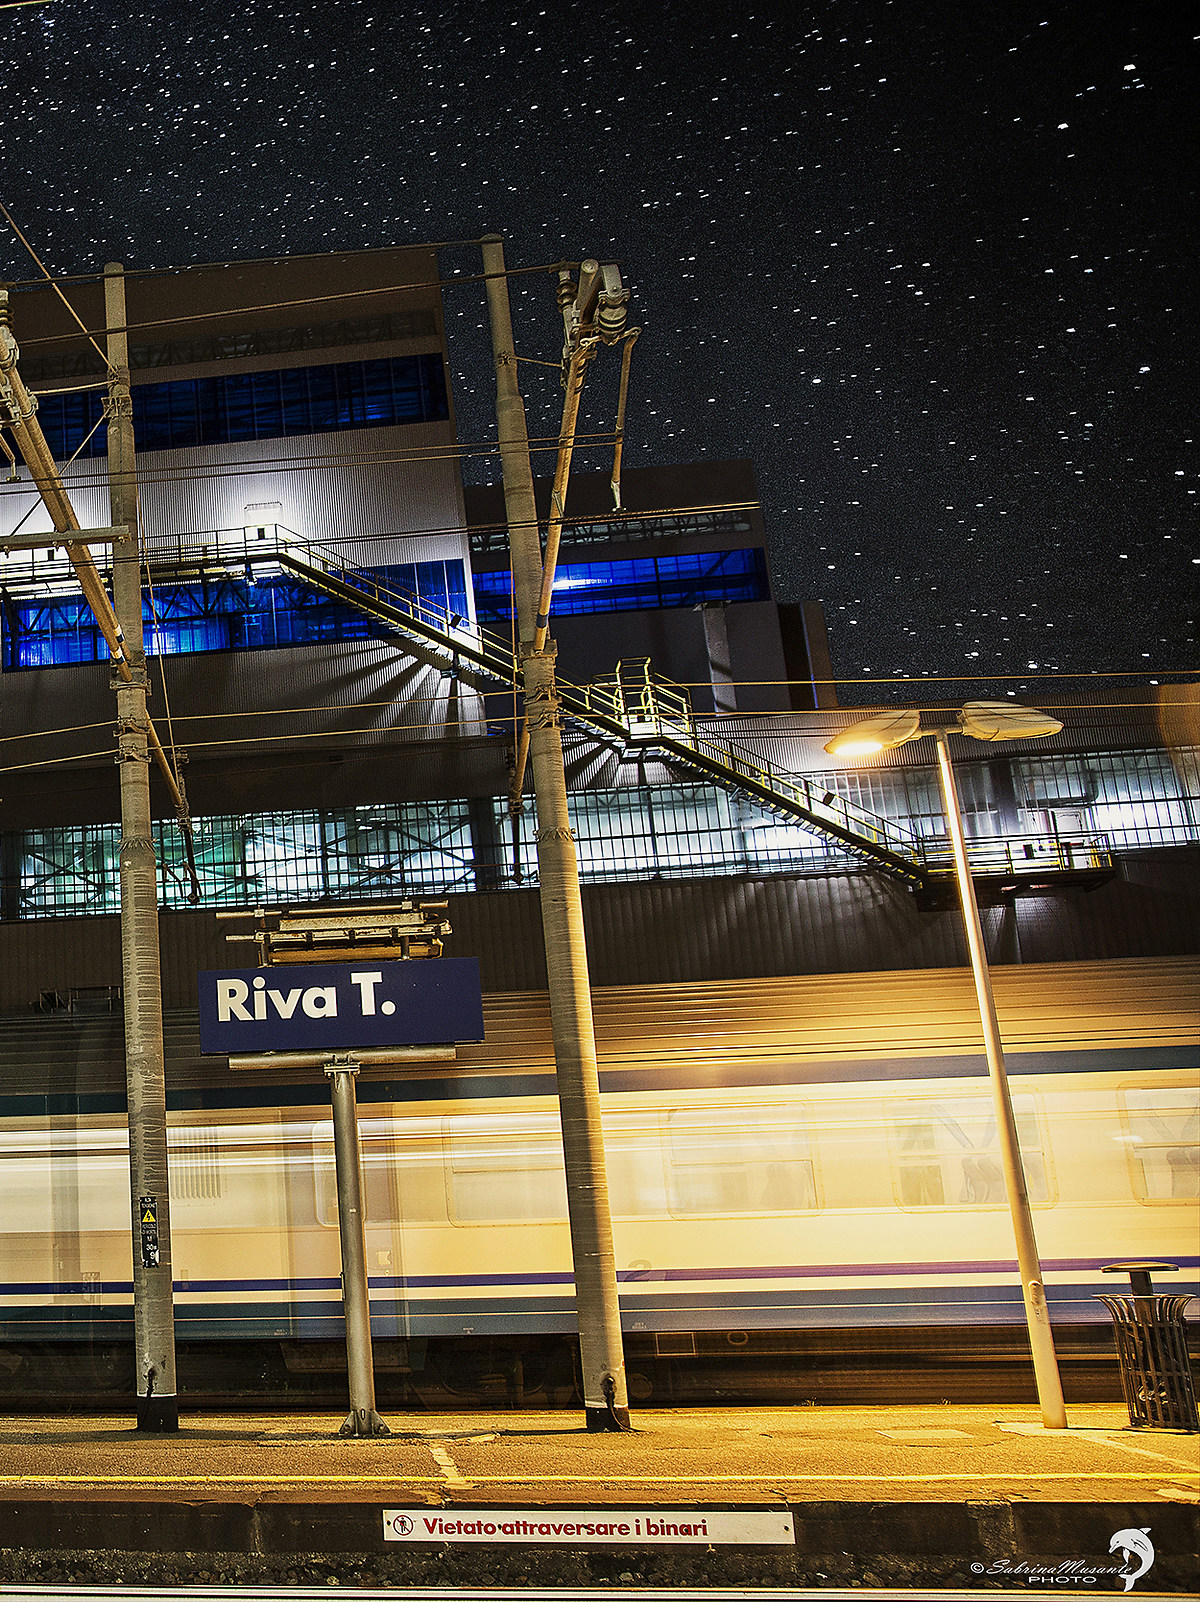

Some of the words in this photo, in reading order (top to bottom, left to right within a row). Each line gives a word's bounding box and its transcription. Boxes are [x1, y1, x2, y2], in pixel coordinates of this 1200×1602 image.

[216, 976, 338, 1022] Riva
[351, 971, 397, 1016] T.
[423, 1517, 497, 1535] Vietato
[501, 1520, 631, 1536] attraversare
[634, 1518, 642, 1536] i
[645, 1517, 708, 1536] binari
